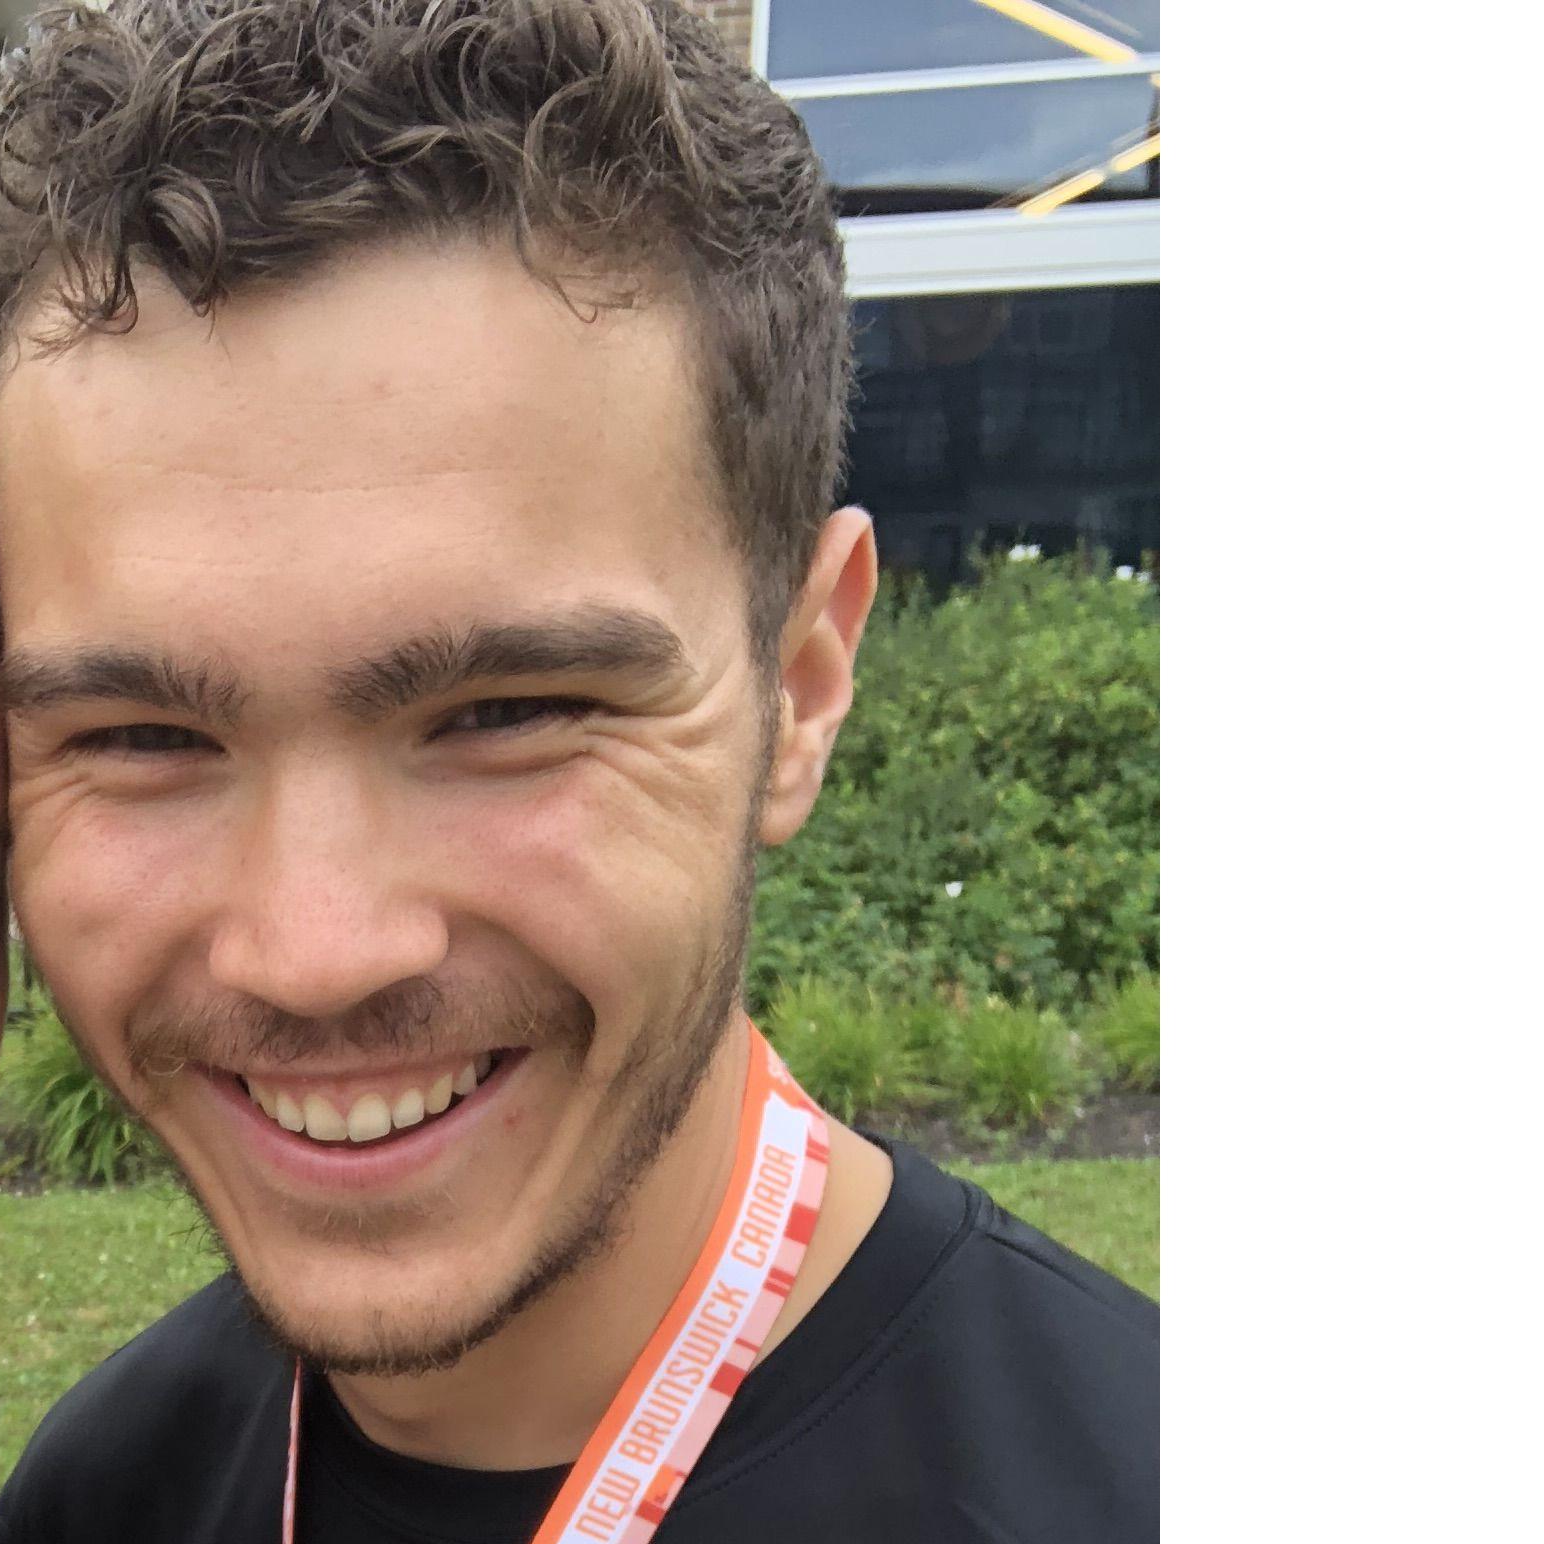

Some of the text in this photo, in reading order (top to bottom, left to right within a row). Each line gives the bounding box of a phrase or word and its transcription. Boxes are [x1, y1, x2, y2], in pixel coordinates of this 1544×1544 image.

[575, 1470, 643, 1543] NEW
[618, 1280, 750, 1467] BRUNSWICK
[730, 1142, 798, 1270] CANADA
